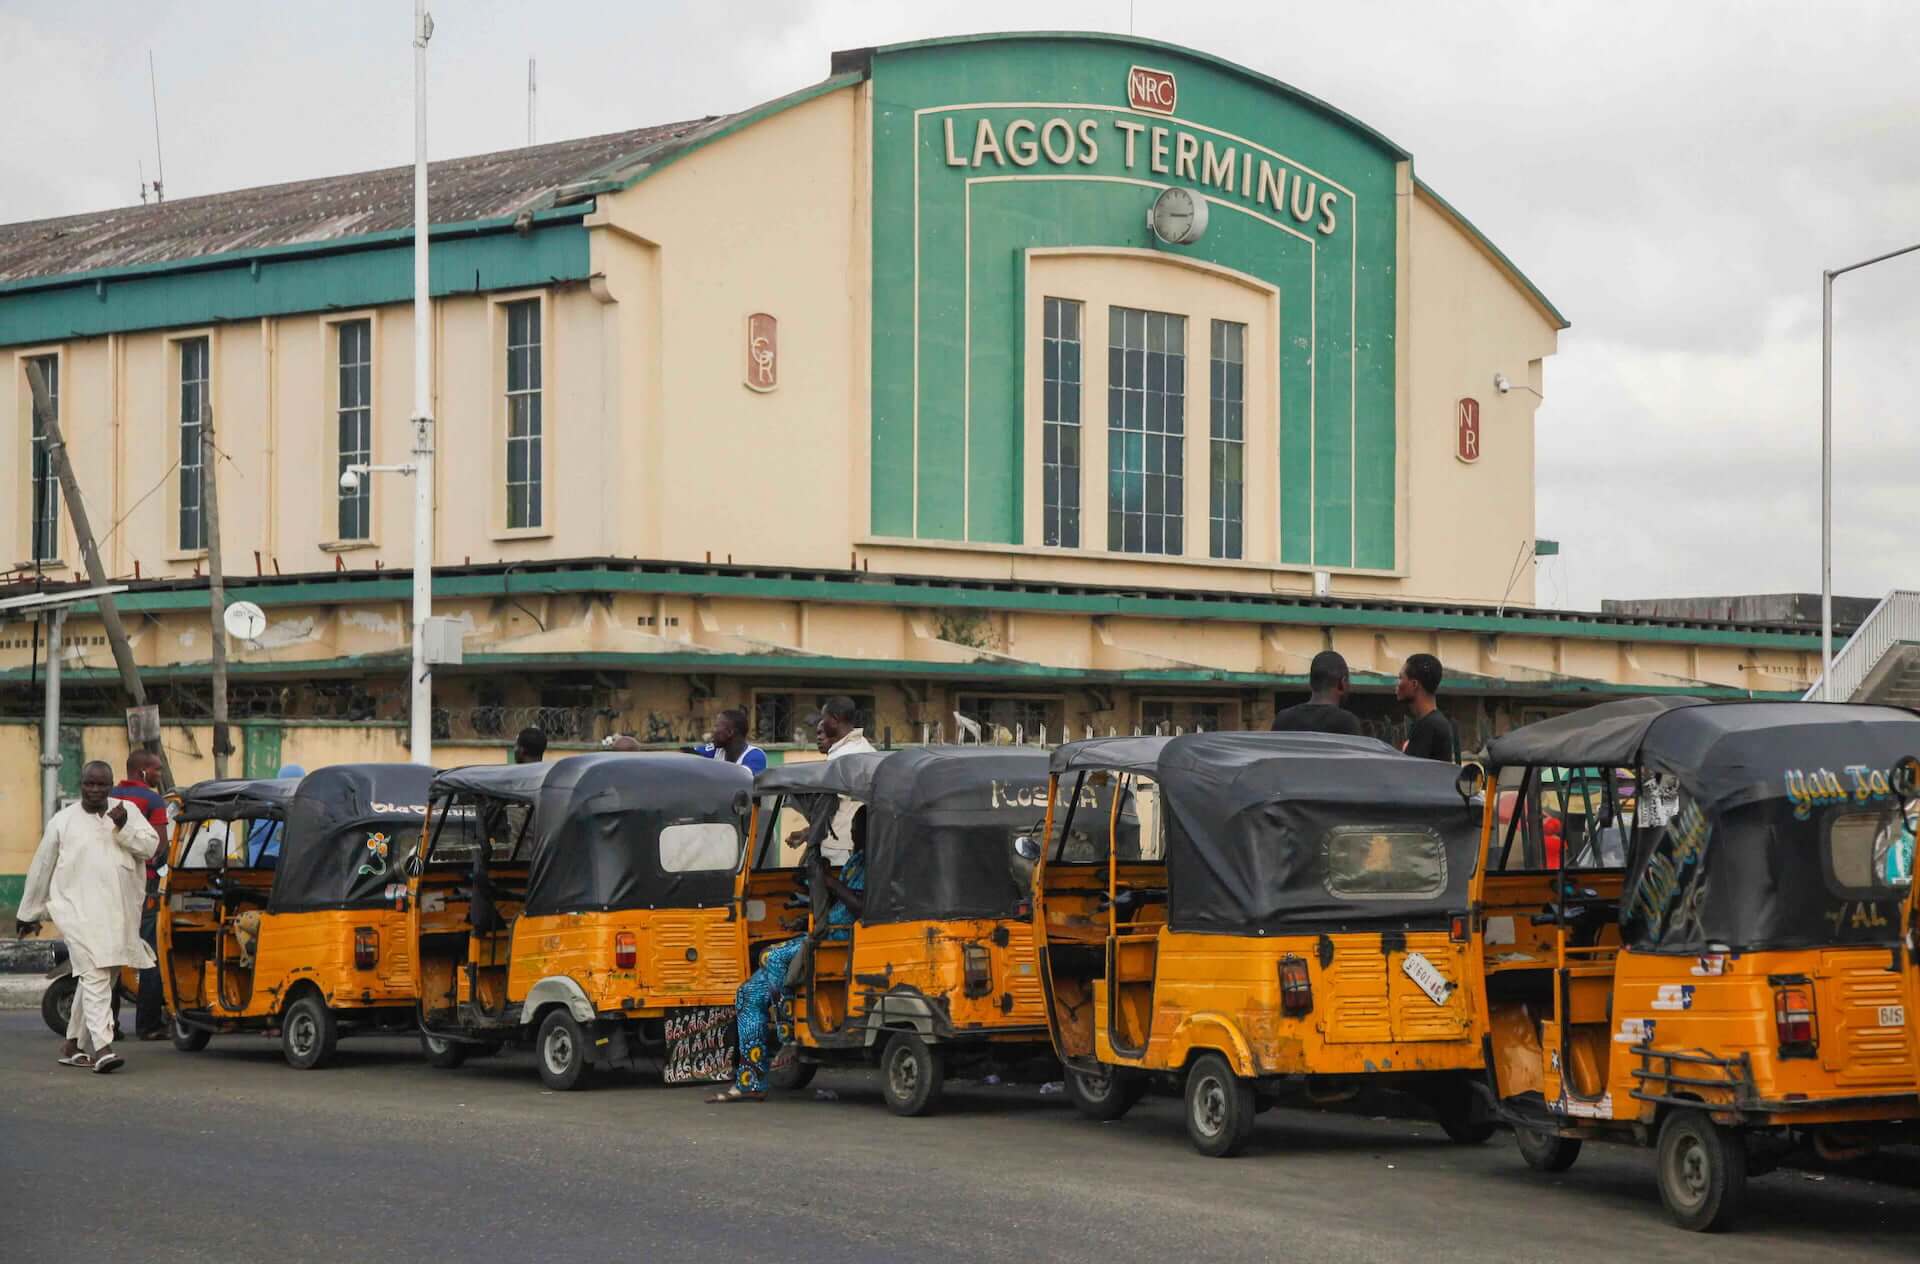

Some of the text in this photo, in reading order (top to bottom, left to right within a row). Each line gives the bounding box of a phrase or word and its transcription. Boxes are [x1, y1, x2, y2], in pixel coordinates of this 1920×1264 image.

[1131, 71, 1173, 105] NRC
[943, 117, 1338, 236] LAGOS TERMINUS
[1460, 402, 1477, 457] NR
